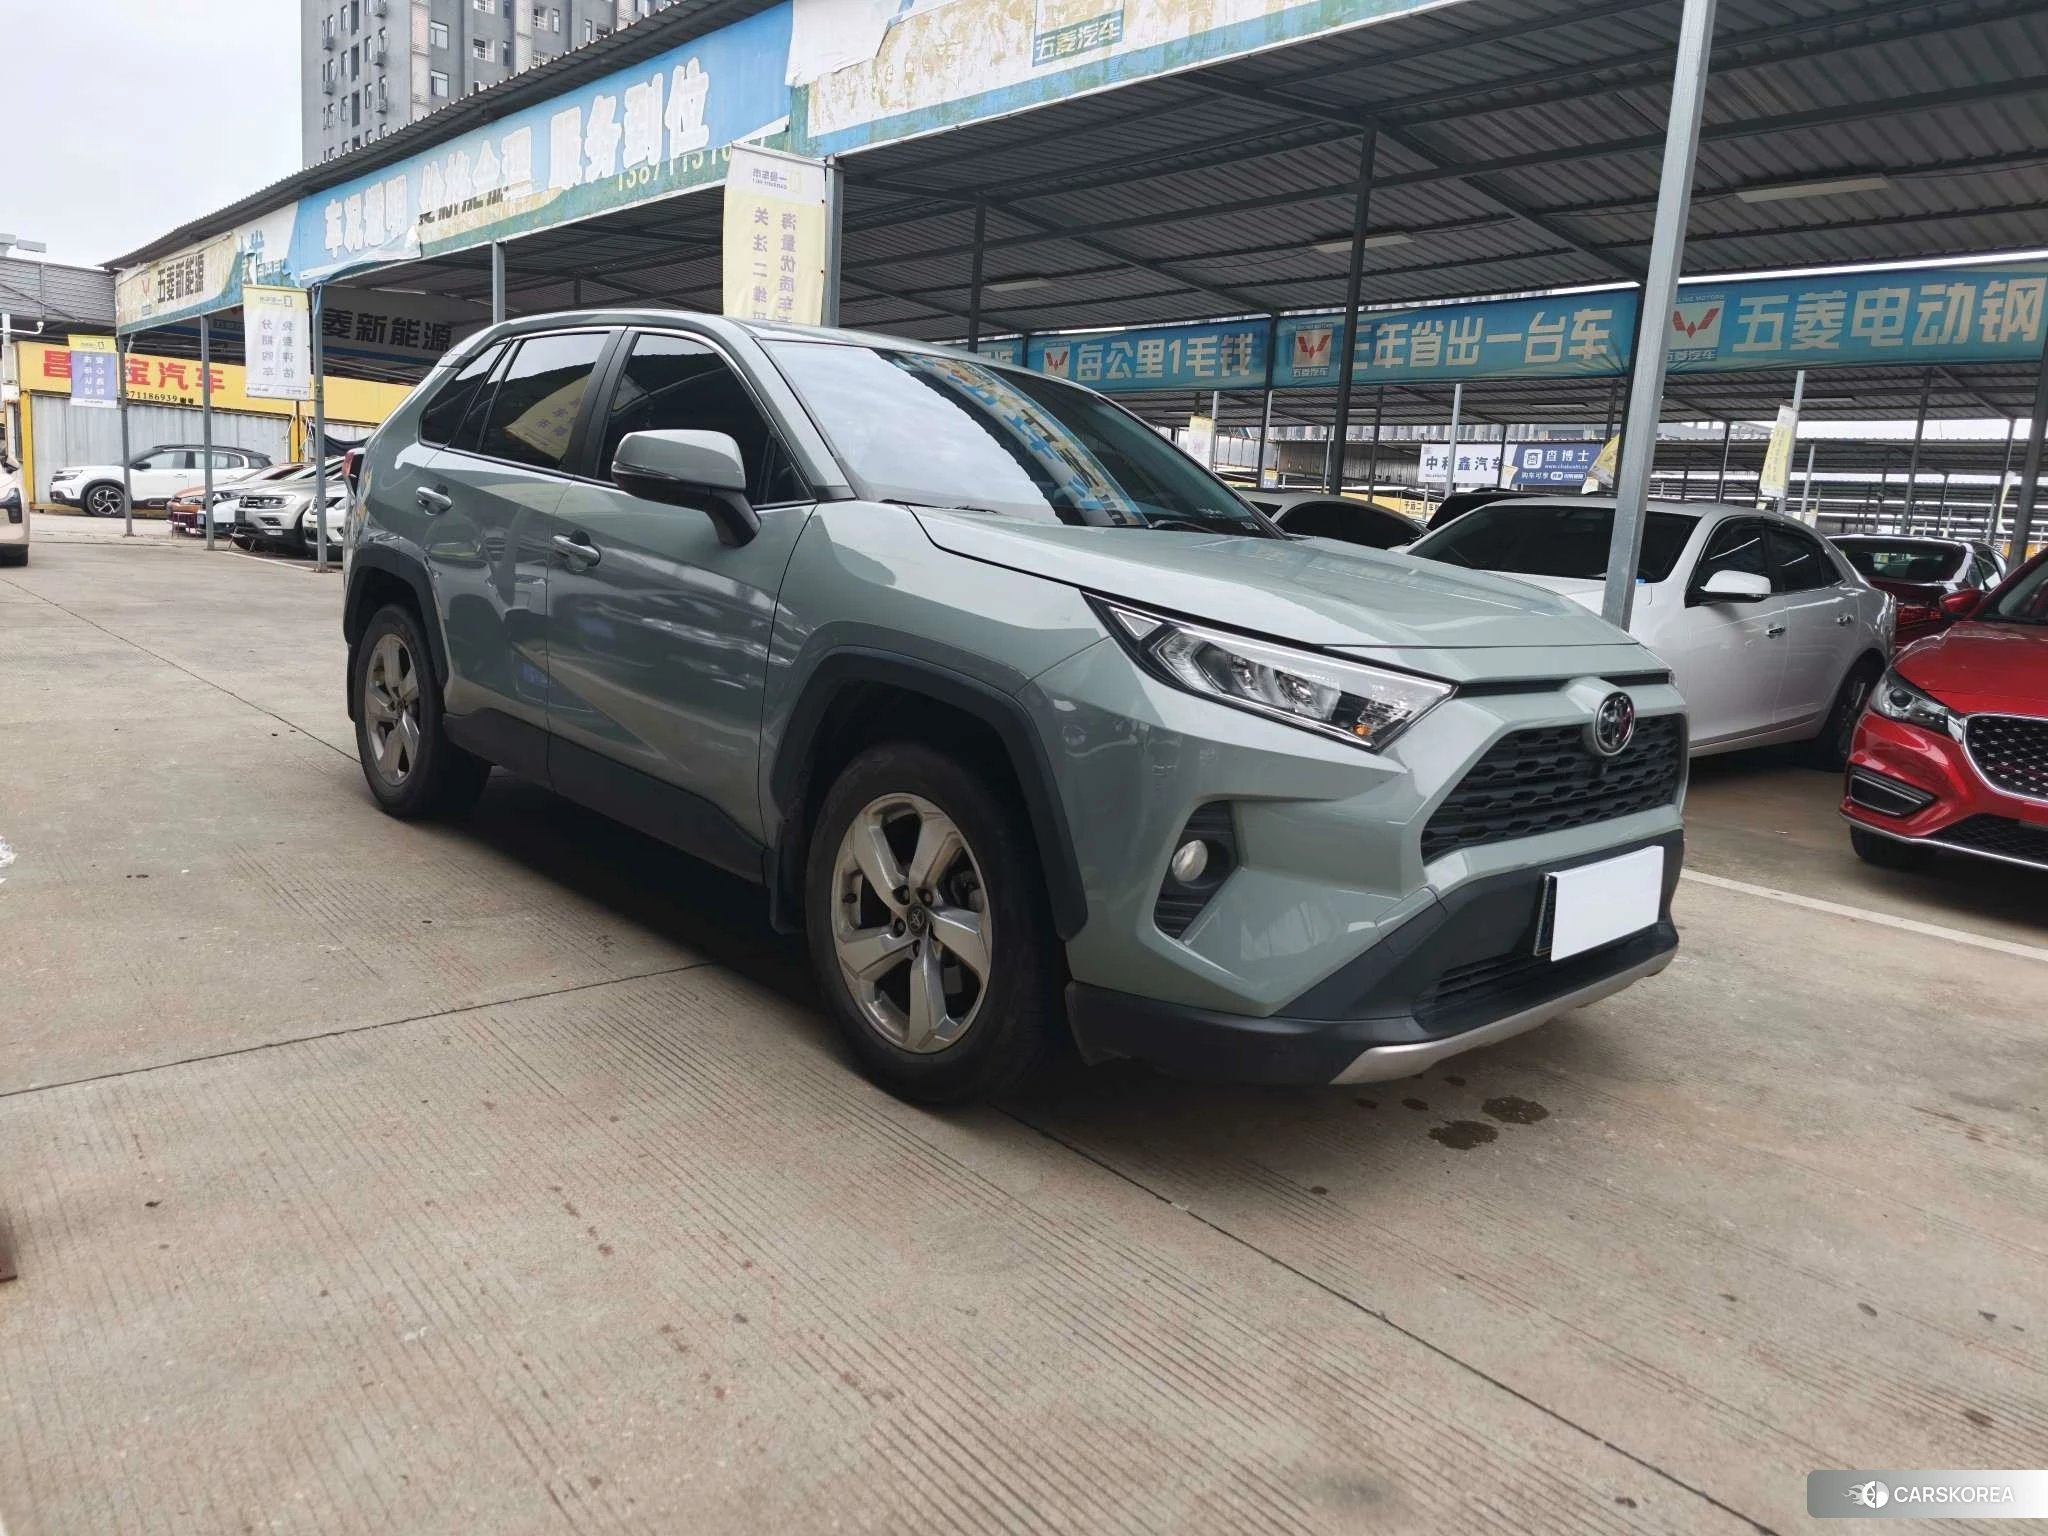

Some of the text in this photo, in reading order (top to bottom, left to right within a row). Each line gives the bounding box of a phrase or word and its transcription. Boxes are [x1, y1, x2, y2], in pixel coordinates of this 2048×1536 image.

[1034, 16, 1121, 61] 五菱汽车
[157, 253, 204, 303] 五菱新能源
[1732, 276, 2047, 352] 五菱电动钢
[1077, 332, 1254, 381] 每公里1毛钱
[1352, 308, 1613, 370] 三年省出一台车
[43, 350, 226, 394] 昌宝汽车
[1546, 449, 1590, 462] 查博士
